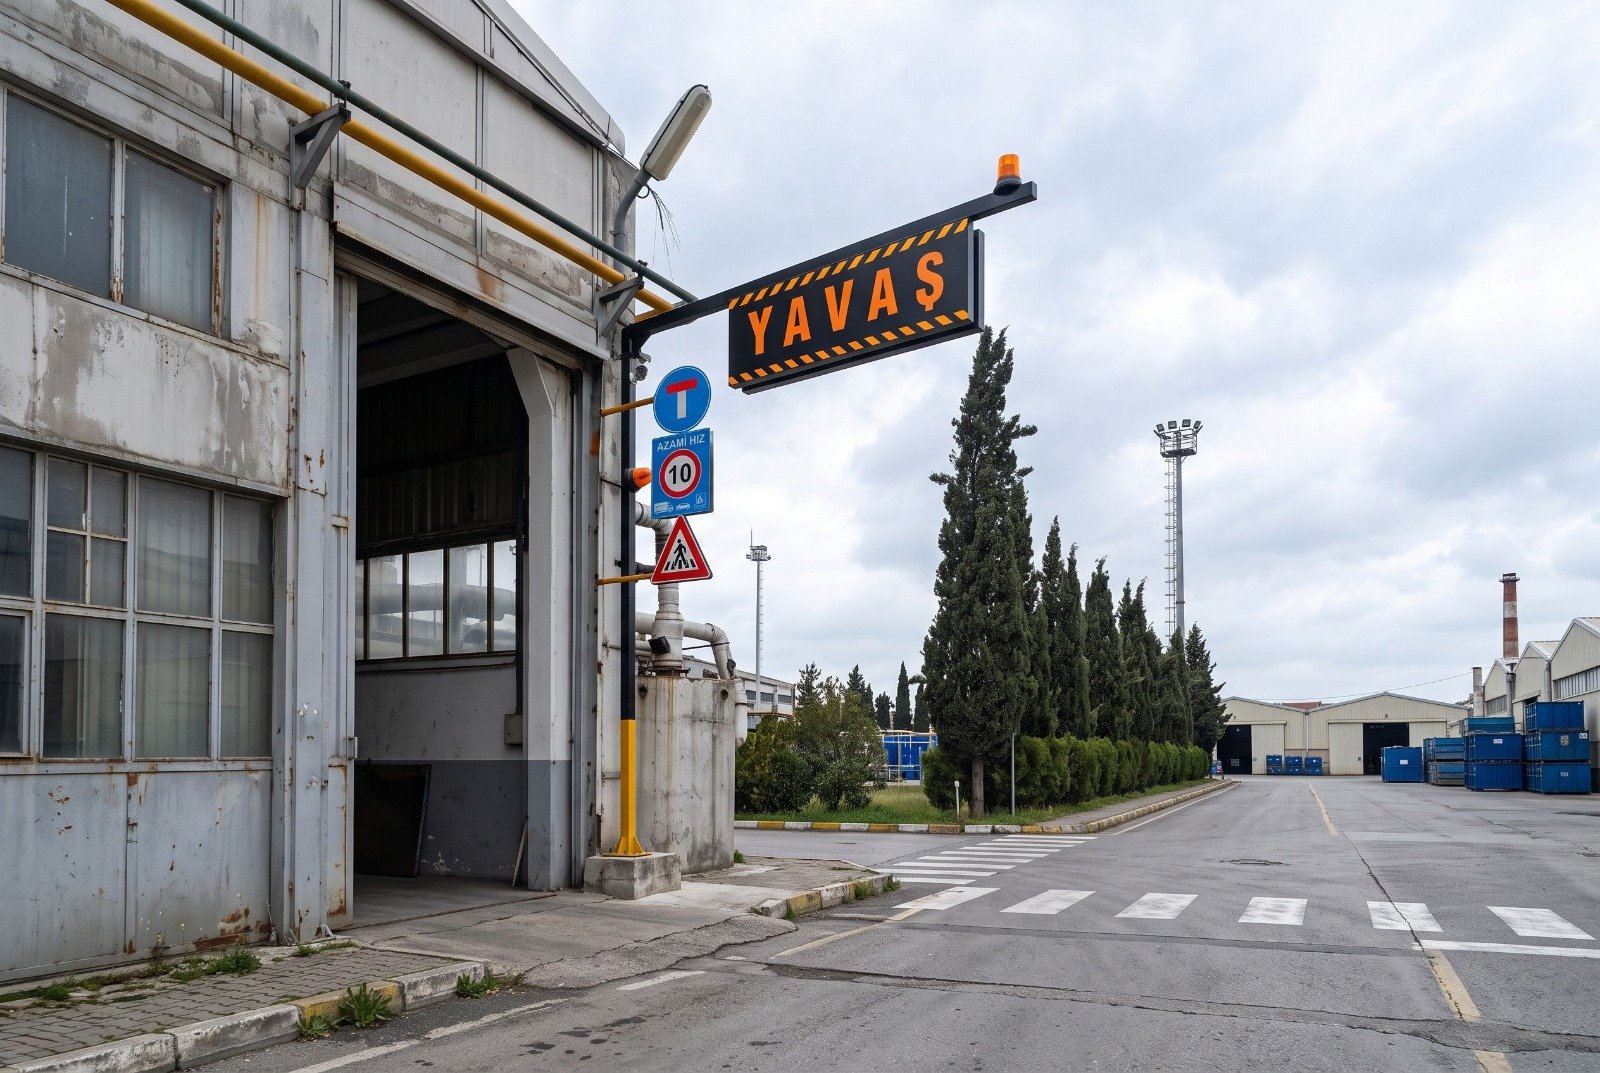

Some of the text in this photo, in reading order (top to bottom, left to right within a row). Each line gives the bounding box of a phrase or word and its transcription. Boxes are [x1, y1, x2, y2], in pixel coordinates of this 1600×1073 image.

[747, 251, 945, 356] YAVAŞ
[656, 433, 706, 452] AZAMİ HIZ
[668, 462, 692, 485] 10
